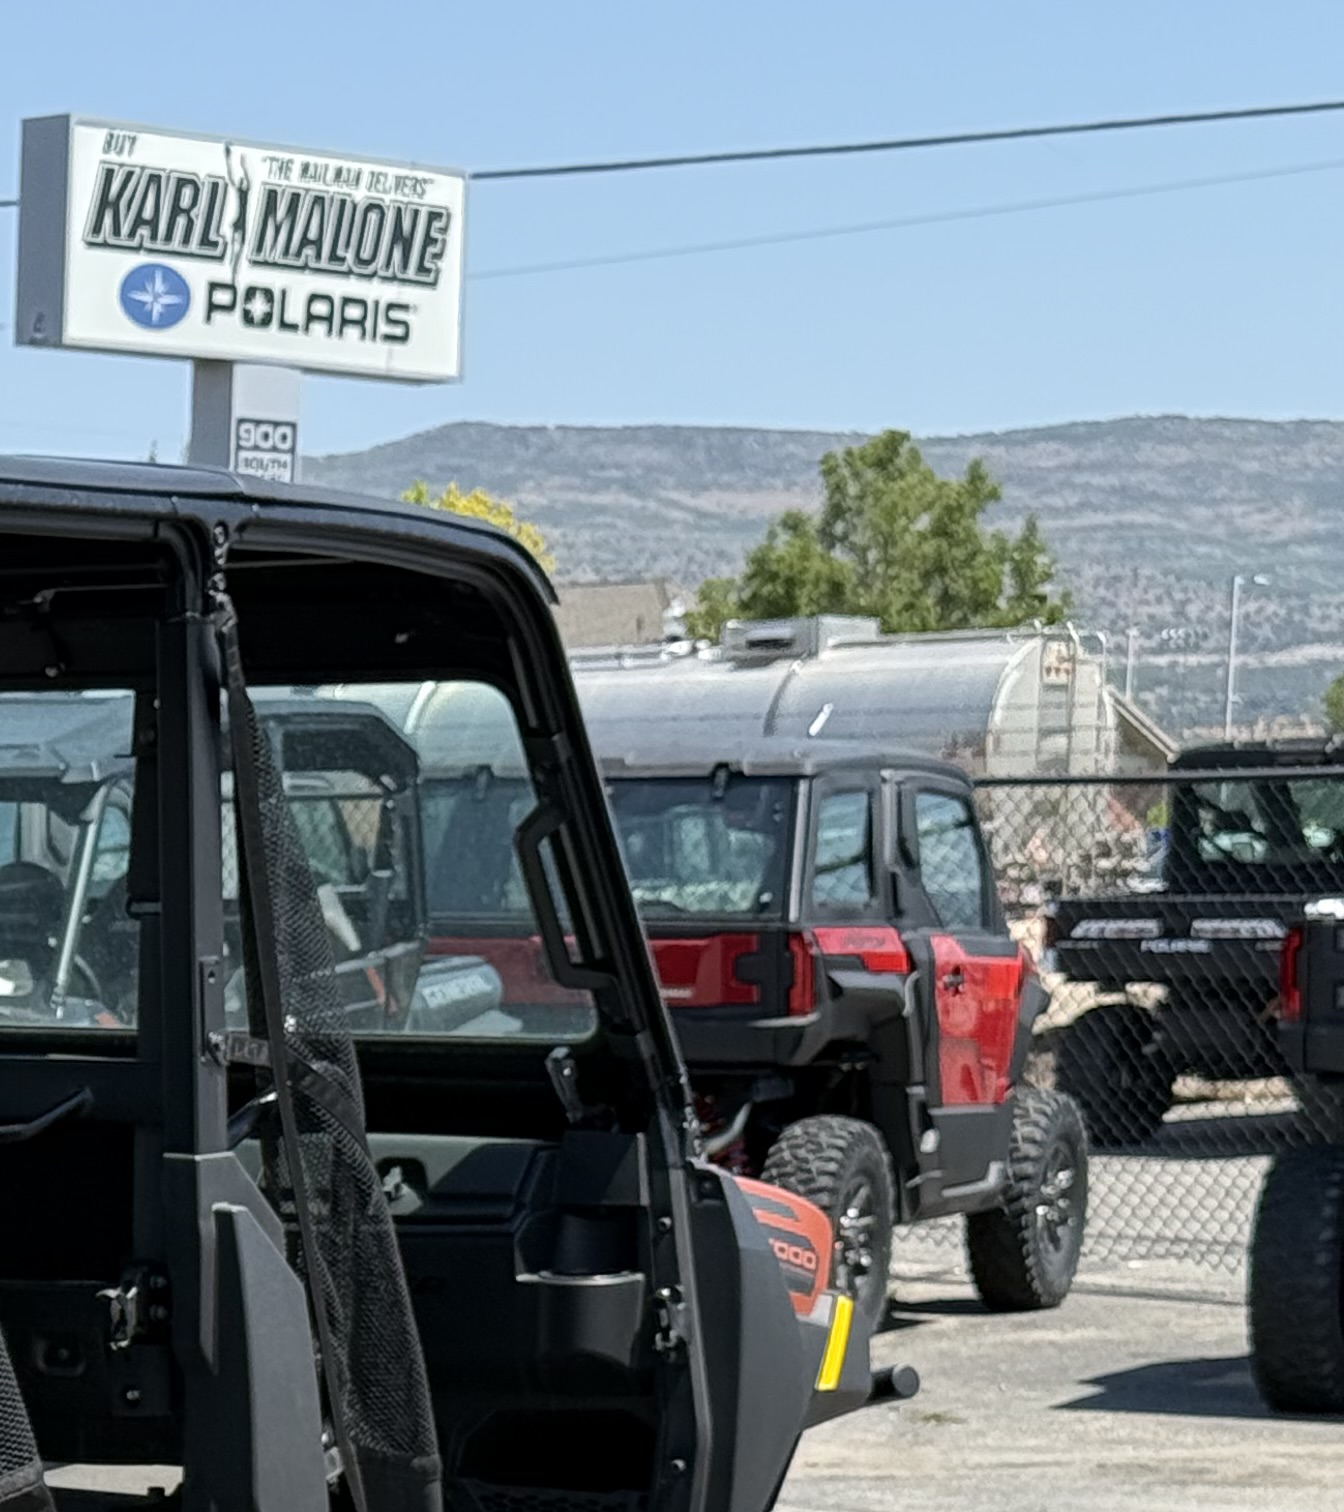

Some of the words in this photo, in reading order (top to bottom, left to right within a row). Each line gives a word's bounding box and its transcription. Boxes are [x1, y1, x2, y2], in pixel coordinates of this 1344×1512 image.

[102, 131, 137, 158] BUY
[84, 161, 228, 259] KARL
[248, 182, 451, 290] MALONE
[204, 281, 411, 345] POLARIS
[239, 423, 293, 450] 900
